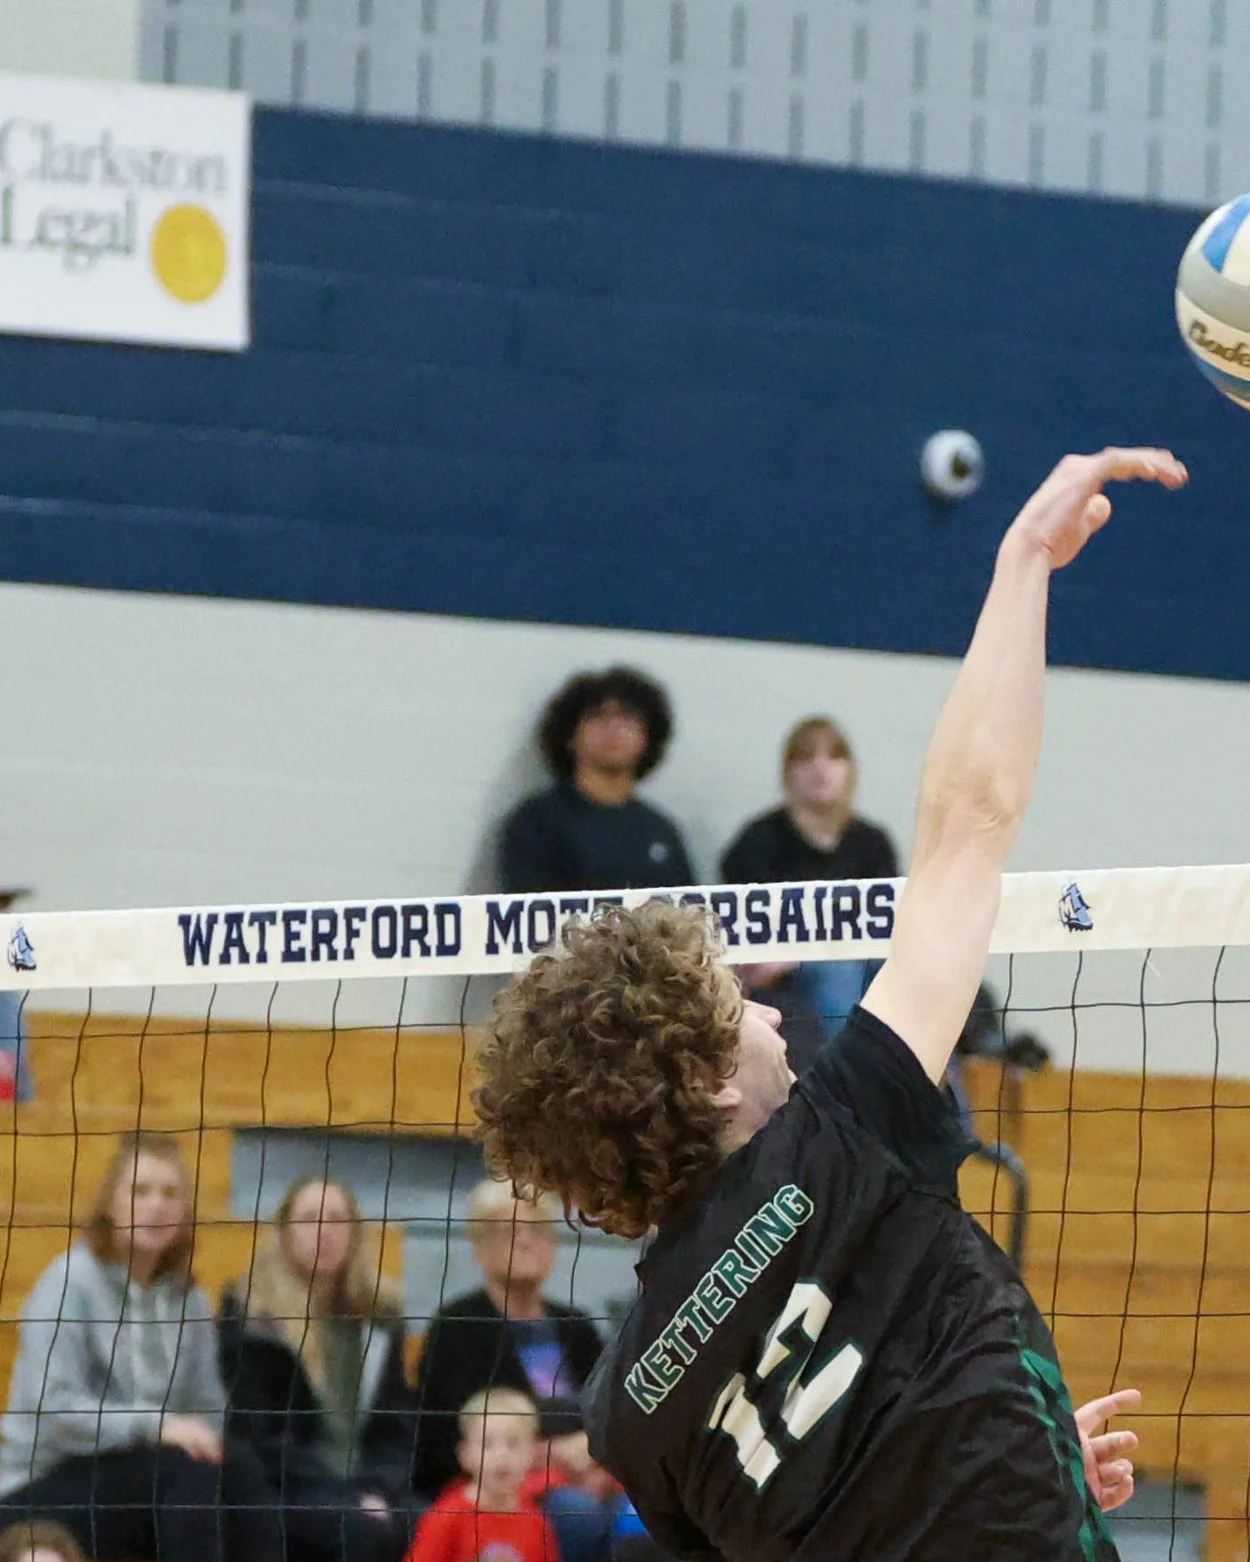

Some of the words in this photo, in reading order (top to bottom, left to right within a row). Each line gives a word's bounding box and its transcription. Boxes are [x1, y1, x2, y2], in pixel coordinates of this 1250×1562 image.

[2, 186, 136, 276] Legal
[178, 902, 462, 967] WATERFORD
[485, 896, 624, 955] MO
[646, 883, 895, 946] RSAIRS
[624, 1184, 815, 1415] KETTERING
[705, 1278, 865, 1491] 12
